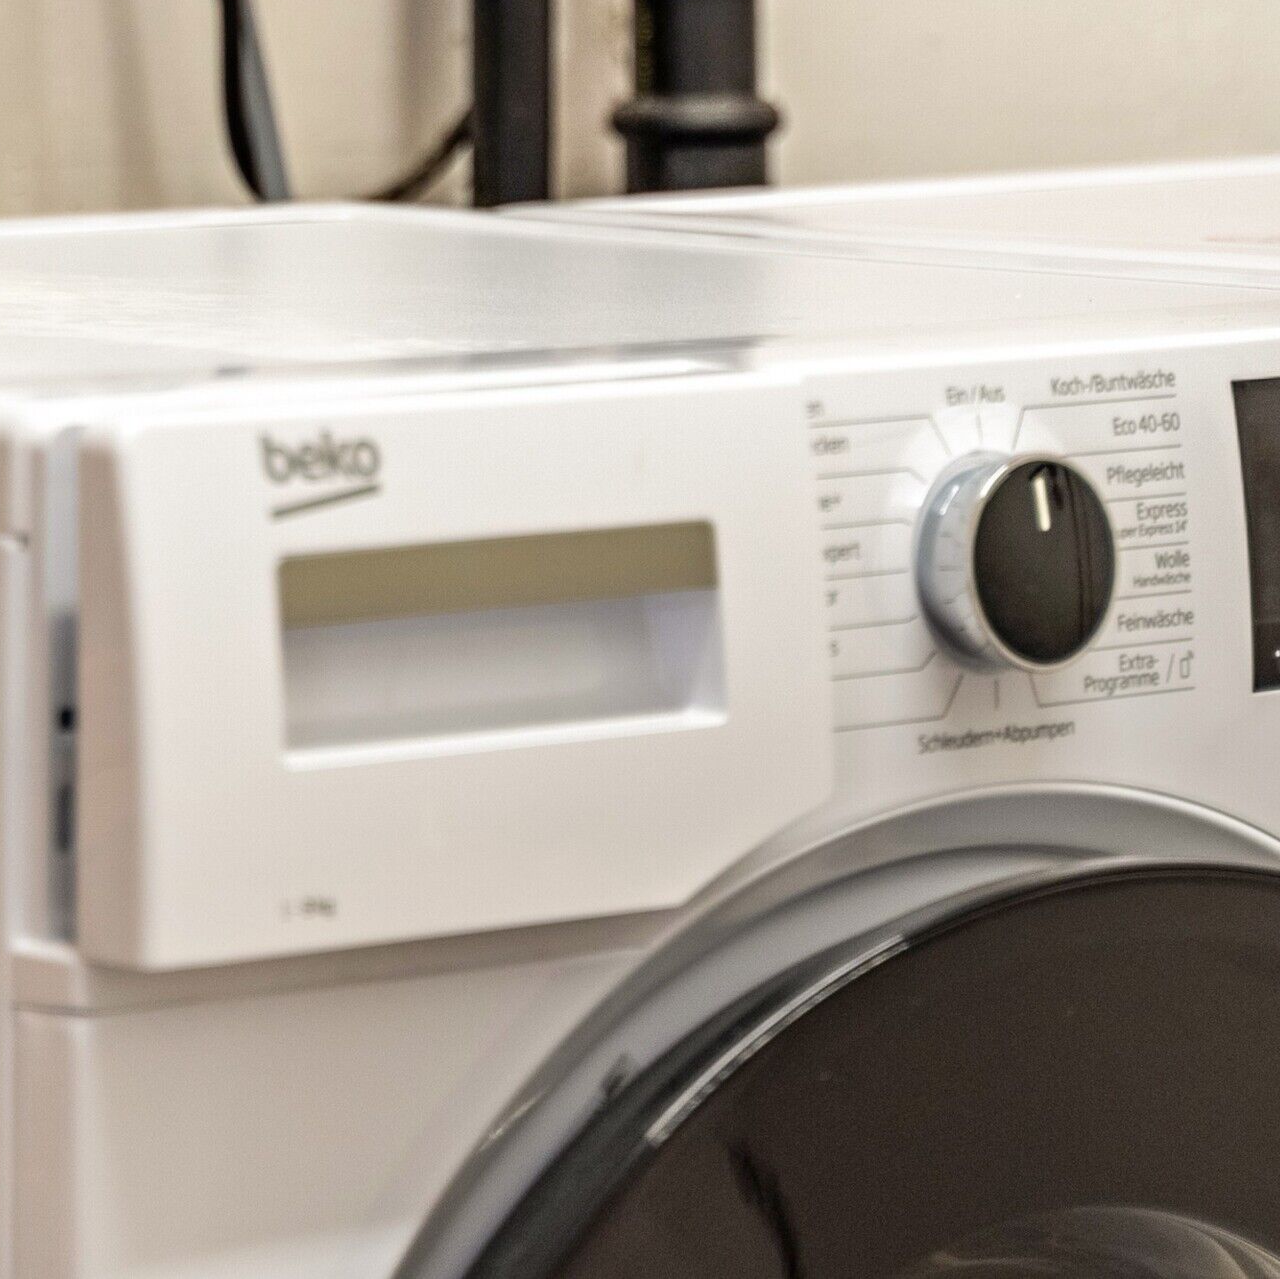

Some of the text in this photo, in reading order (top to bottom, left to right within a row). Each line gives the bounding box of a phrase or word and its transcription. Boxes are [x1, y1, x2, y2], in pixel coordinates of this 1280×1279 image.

[1050, 369, 1176, 396] Koch-/Buntwäsche
[1112, 412, 1181, 436] Eco 40-60
[262, 428, 381, 484] beko
[1106, 462, 1185, 488] Pflegeleicht
[1136, 502, 1188, 522] Express
[1154, 549, 1190, 569] Wolle
[1117, 608, 1194, 632] Feinwäsche
[1083, 671, 1160, 697] Programme
